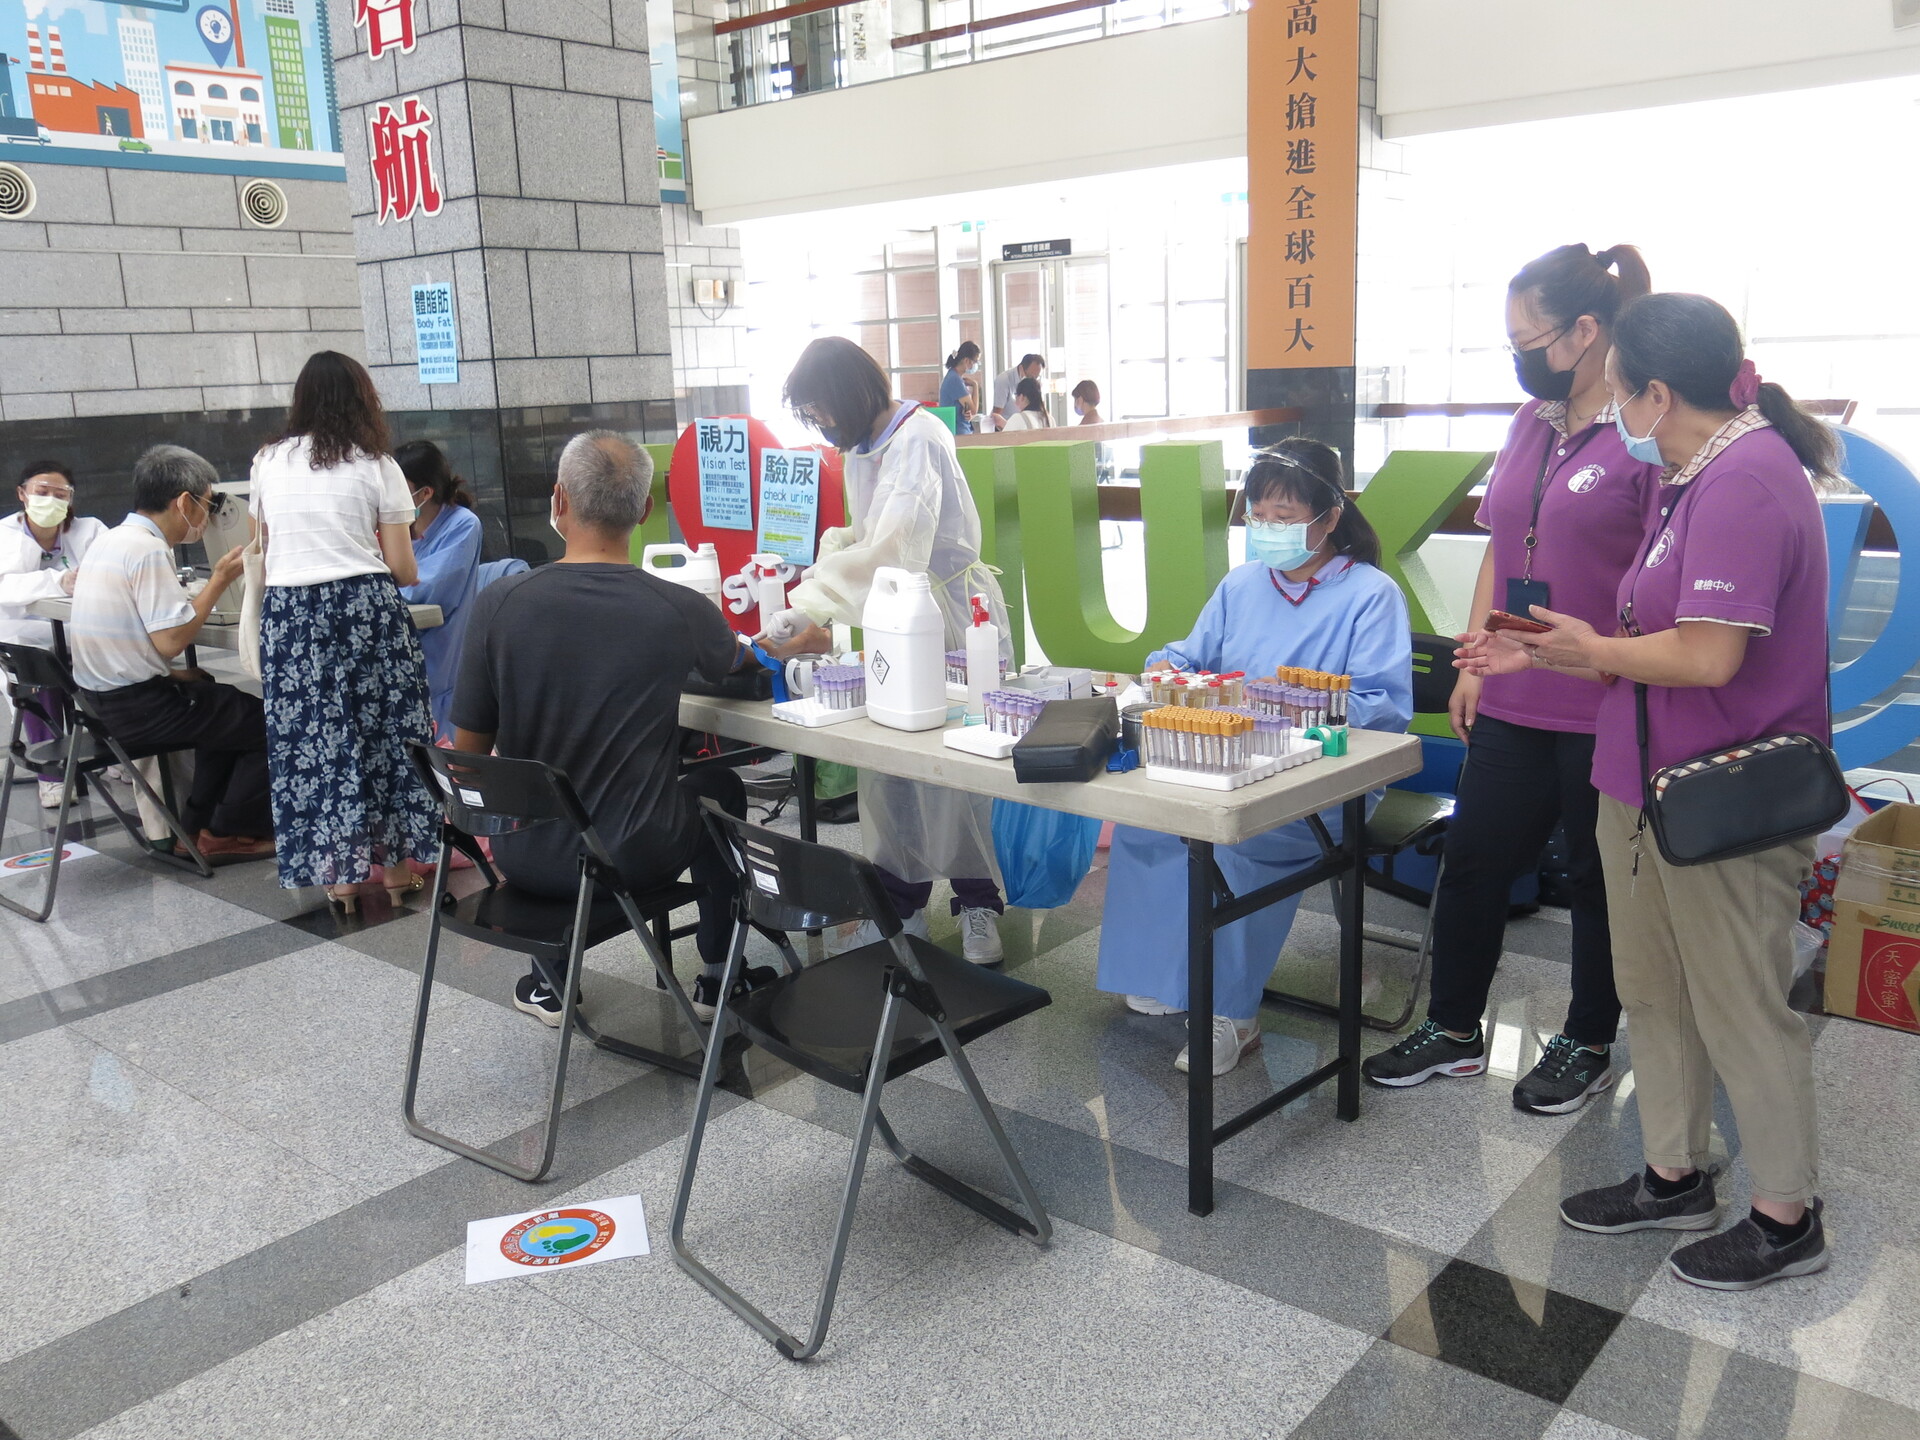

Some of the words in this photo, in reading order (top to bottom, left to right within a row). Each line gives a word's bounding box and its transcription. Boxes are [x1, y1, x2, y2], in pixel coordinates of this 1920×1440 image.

[1284, 0, 1318, 353] 高大搶進全球百大
[414, 288, 448, 315] 體脂肪
[417, 317, 434, 329] Body
[437, 316, 452, 327] Fat
[700, 425, 745, 453] 視力
[701, 455, 727, 470] Vision
[730, 457, 747, 471] Test
[764, 454, 815, 487] 驗尿
[763, 487, 787, 502] check
[790, 490, 814, 505] urine
[1693, 579, 1736, 593] 健檢中心
[1880, 950, 1904, 1010] 天蜜蜜
